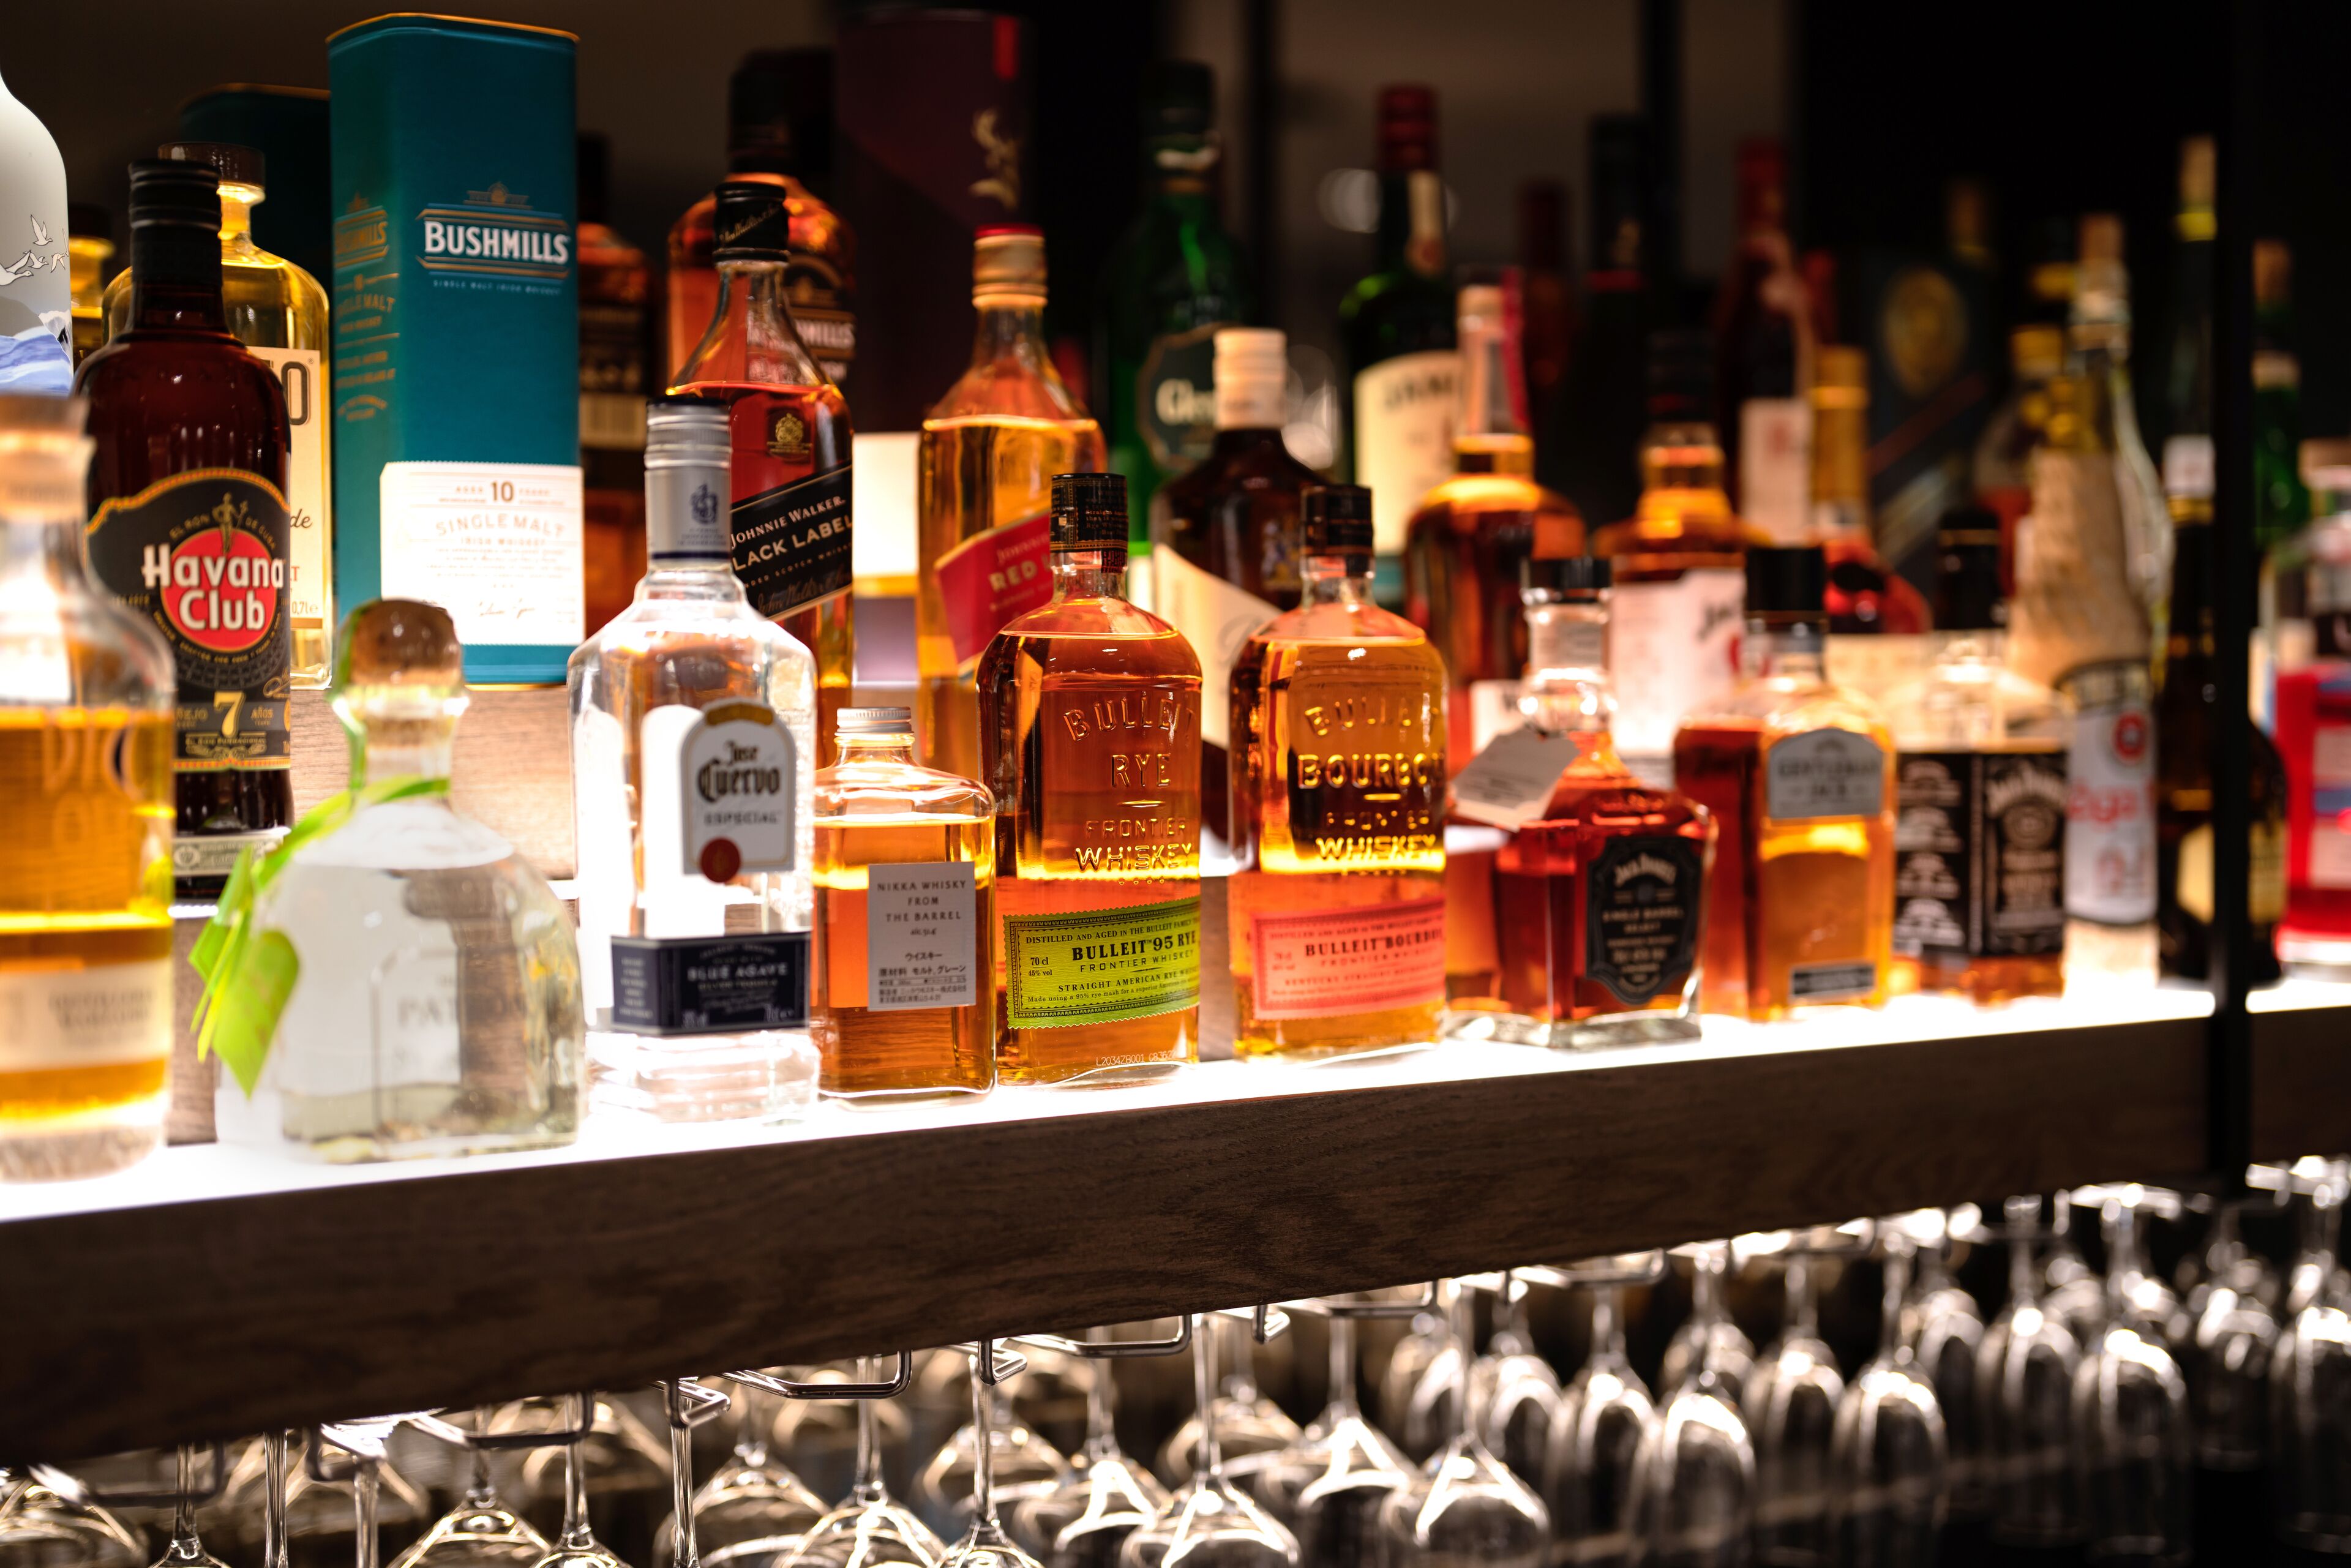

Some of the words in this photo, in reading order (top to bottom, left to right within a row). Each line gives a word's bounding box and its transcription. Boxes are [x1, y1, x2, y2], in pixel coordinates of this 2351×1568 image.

[424, 220, 569, 264] BUSHMILLS
[490, 480, 515, 503] 10
[435, 514, 508, 537] SINGLE
[513, 515, 565, 537] MALT
[730, 516, 787, 549] JOHNNIE
[788, 495, 846, 523] WALKER
[141, 542, 283, 590] Havana
[732, 539, 787, 571] LACK
[988, 560, 1037, 592] RED
[179, 588, 266, 631] Club
[174, 707, 209, 722] ÑEJO
[214, 691, 244, 738] 7
[724, 740, 759, 765] Jose
[697, 757, 780, 803] Cuervo
[1111, 753, 1171, 787] RYE
[705, 812, 778, 826] ESPECIAL
[1085, 817, 1187, 839] FRONTIER
[1075, 842, 1192, 872] WHISKEY
[1316, 833, 1436, 860] WHISKEY
[877, 882, 917, 891] NIKKA
[921, 880, 966, 890] WHISKY
[907, 896, 939, 906] FROM
[886, 913, 909, 922] THE
[915, 911, 961, 921] BARREL
[1026, 934, 1073, 944] DISTILLED
[1095, 931, 1118, 940] AGED
[1146, 923, 1172, 932] BULLEIT
[905, 951, 943, 961] ウイスキー
[1071, 940, 1147, 961] BULLEIT
[1153, 936, 1174, 951] 95
[1178, 930, 1196, 947] RYE
[1305, 937, 1377, 956] BULLEIT
[1030, 956, 1040, 966] 70
[1041, 956, 1049, 965] cl
[1080, 958, 1147, 972] FRONTIER
[1152, 950, 1194, 964] WHISKEY
[1321, 953, 1388, 967] FRONTIER
[688, 966, 730, 981] BLUE
[735, 962, 789, 978] AGAVE
[1058, 980, 1112, 992] STRAIGHT
[1116, 973, 1161, 987] AMERICAN
[1164, 970, 1177, 980] RYE
[1103, 989, 1120, 997] mash
[1096, 1053, 1145, 1066] L2034ZB001
